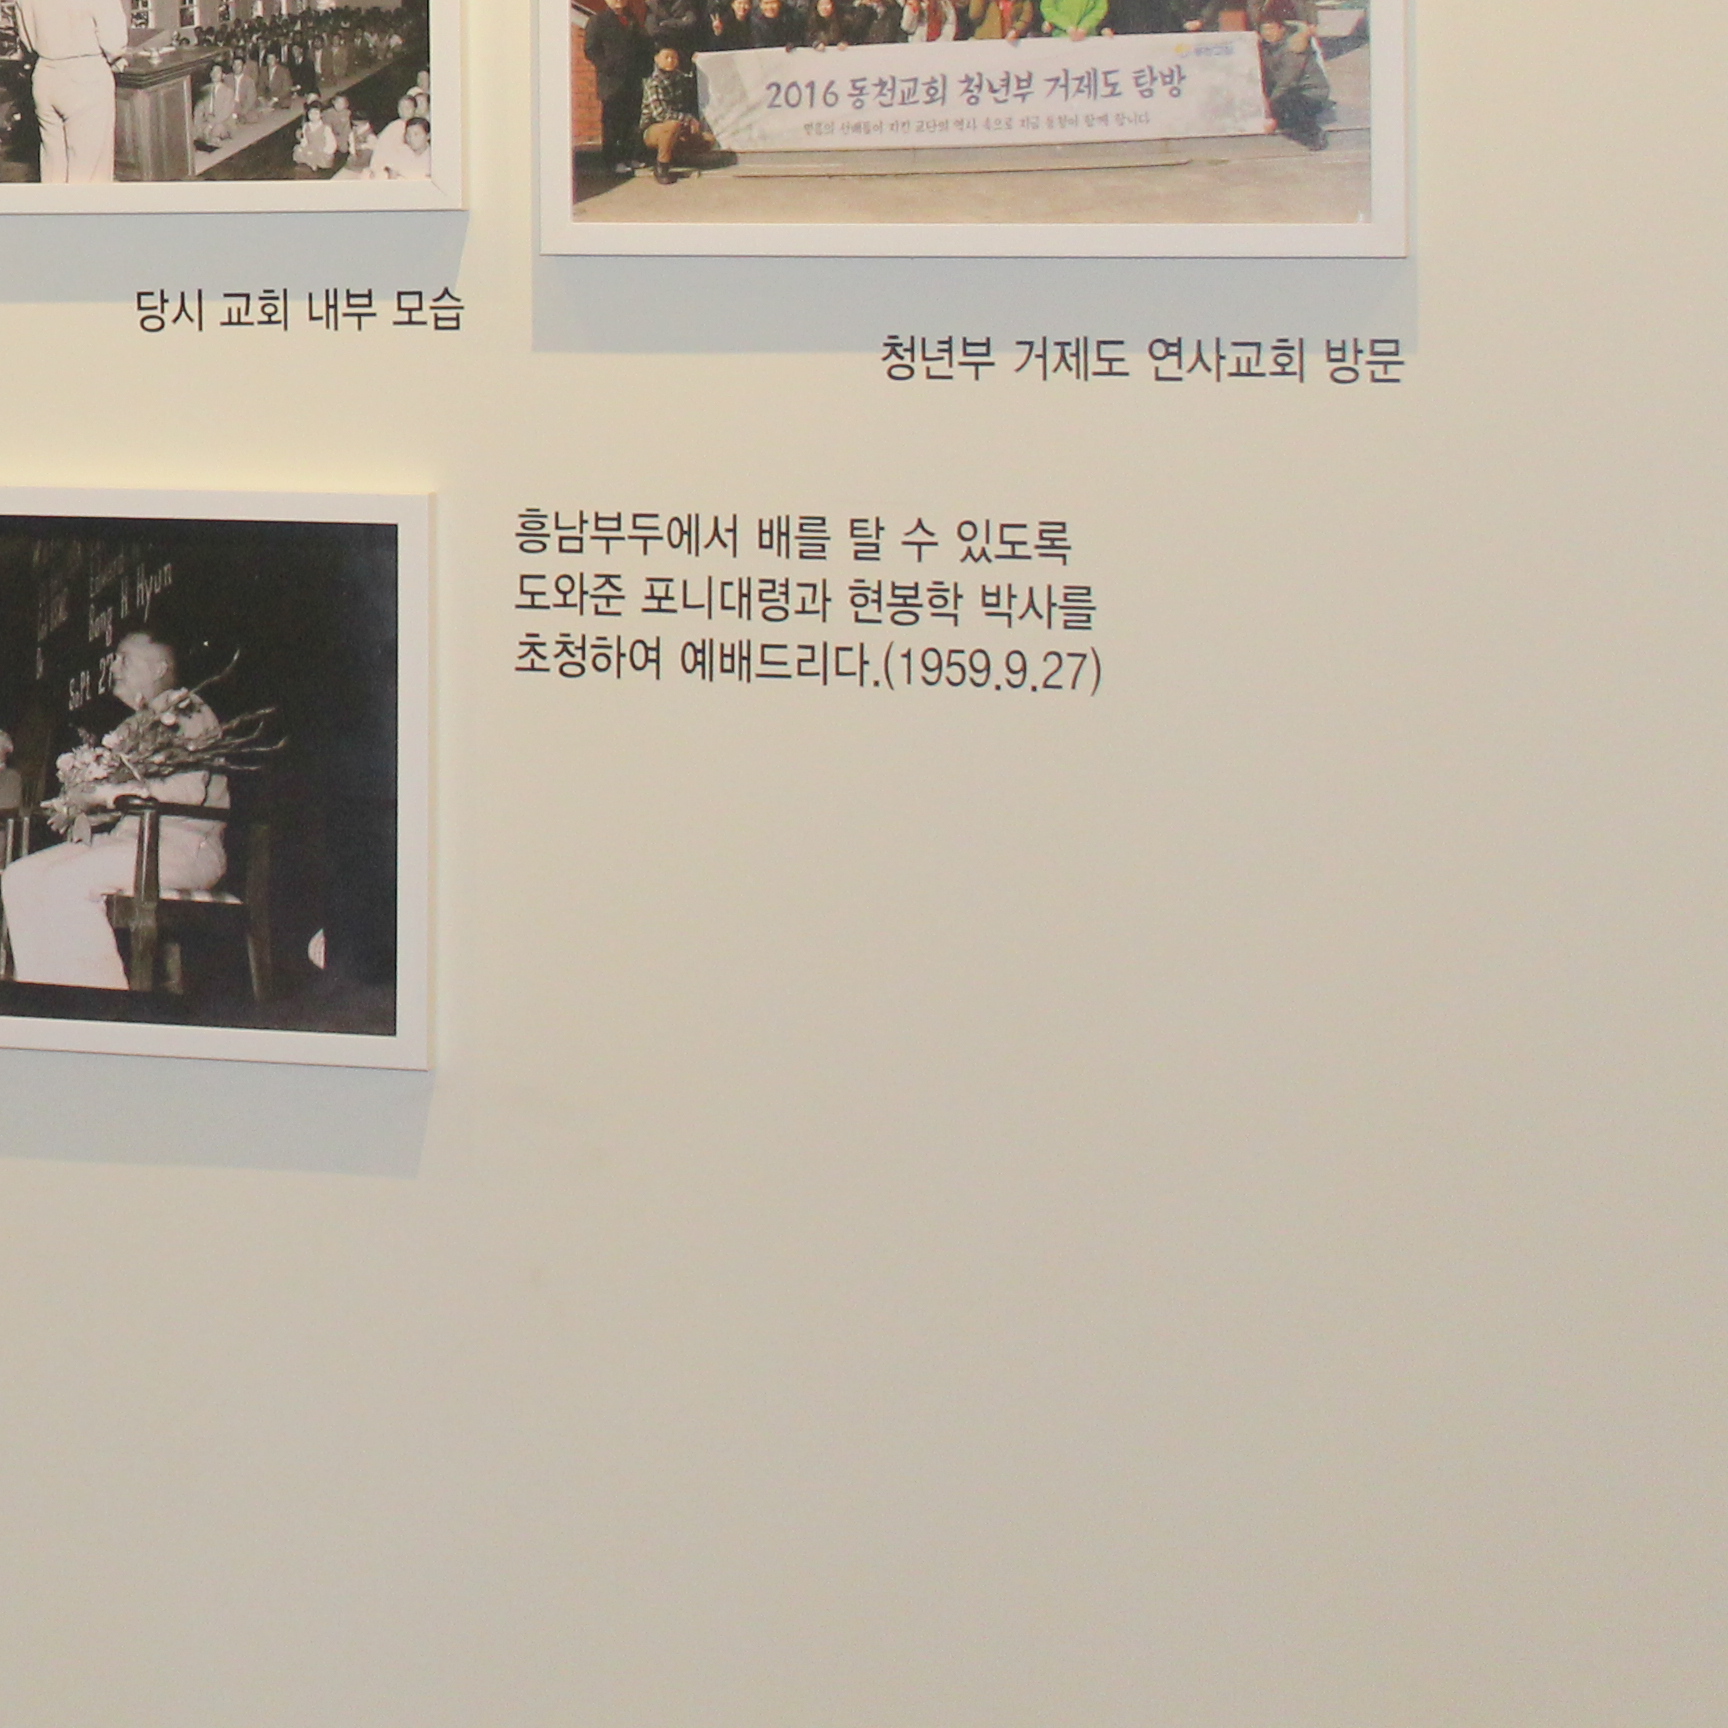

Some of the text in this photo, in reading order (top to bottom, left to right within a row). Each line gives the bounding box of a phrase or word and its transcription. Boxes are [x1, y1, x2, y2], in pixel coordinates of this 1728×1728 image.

[765, 63, 1188, 110] 2016 동천교회 청년부 거제도 탐방
[136, 285, 465, 333] 당시 교회 내부 모습
[881, 334, 1406, 385] 청년부 거제도 연사교회 방문
[514, 507, 1073, 566] 흥남부두에서 배를 탈 수 있도록
[514, 571, 1097, 630] 도와준 포니대령과 현봉학 박사를
[514, 632, 1102, 697] 초청하여 예배드리다.(1959.9.27)
